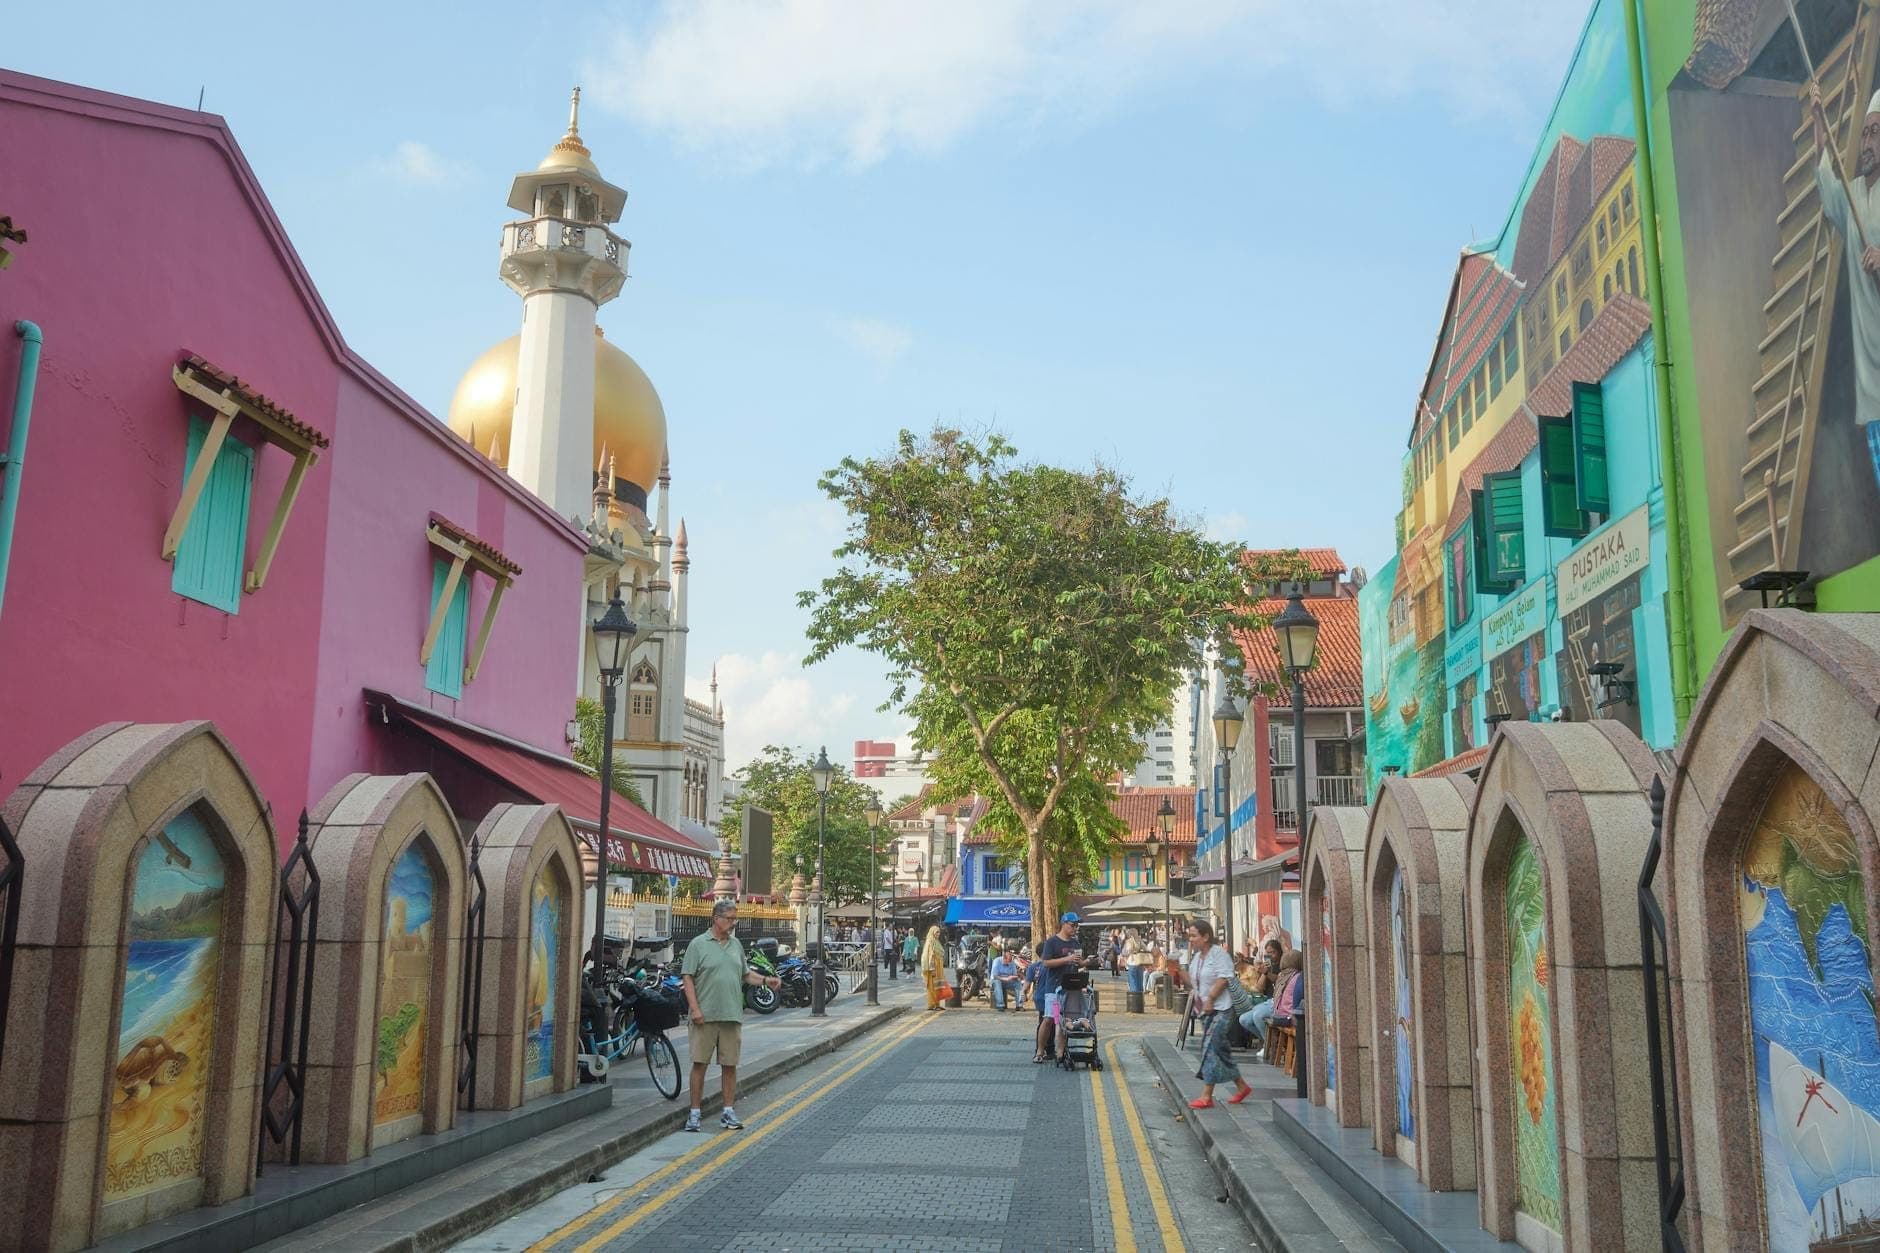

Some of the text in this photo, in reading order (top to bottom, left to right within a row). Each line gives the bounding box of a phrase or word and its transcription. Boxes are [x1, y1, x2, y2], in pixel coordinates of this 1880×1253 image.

[1572, 530, 1625, 584] PUSTAKA
[1582, 560, 1620, 595] MUHAMMAD
[1624, 547, 1640, 568] SAID
